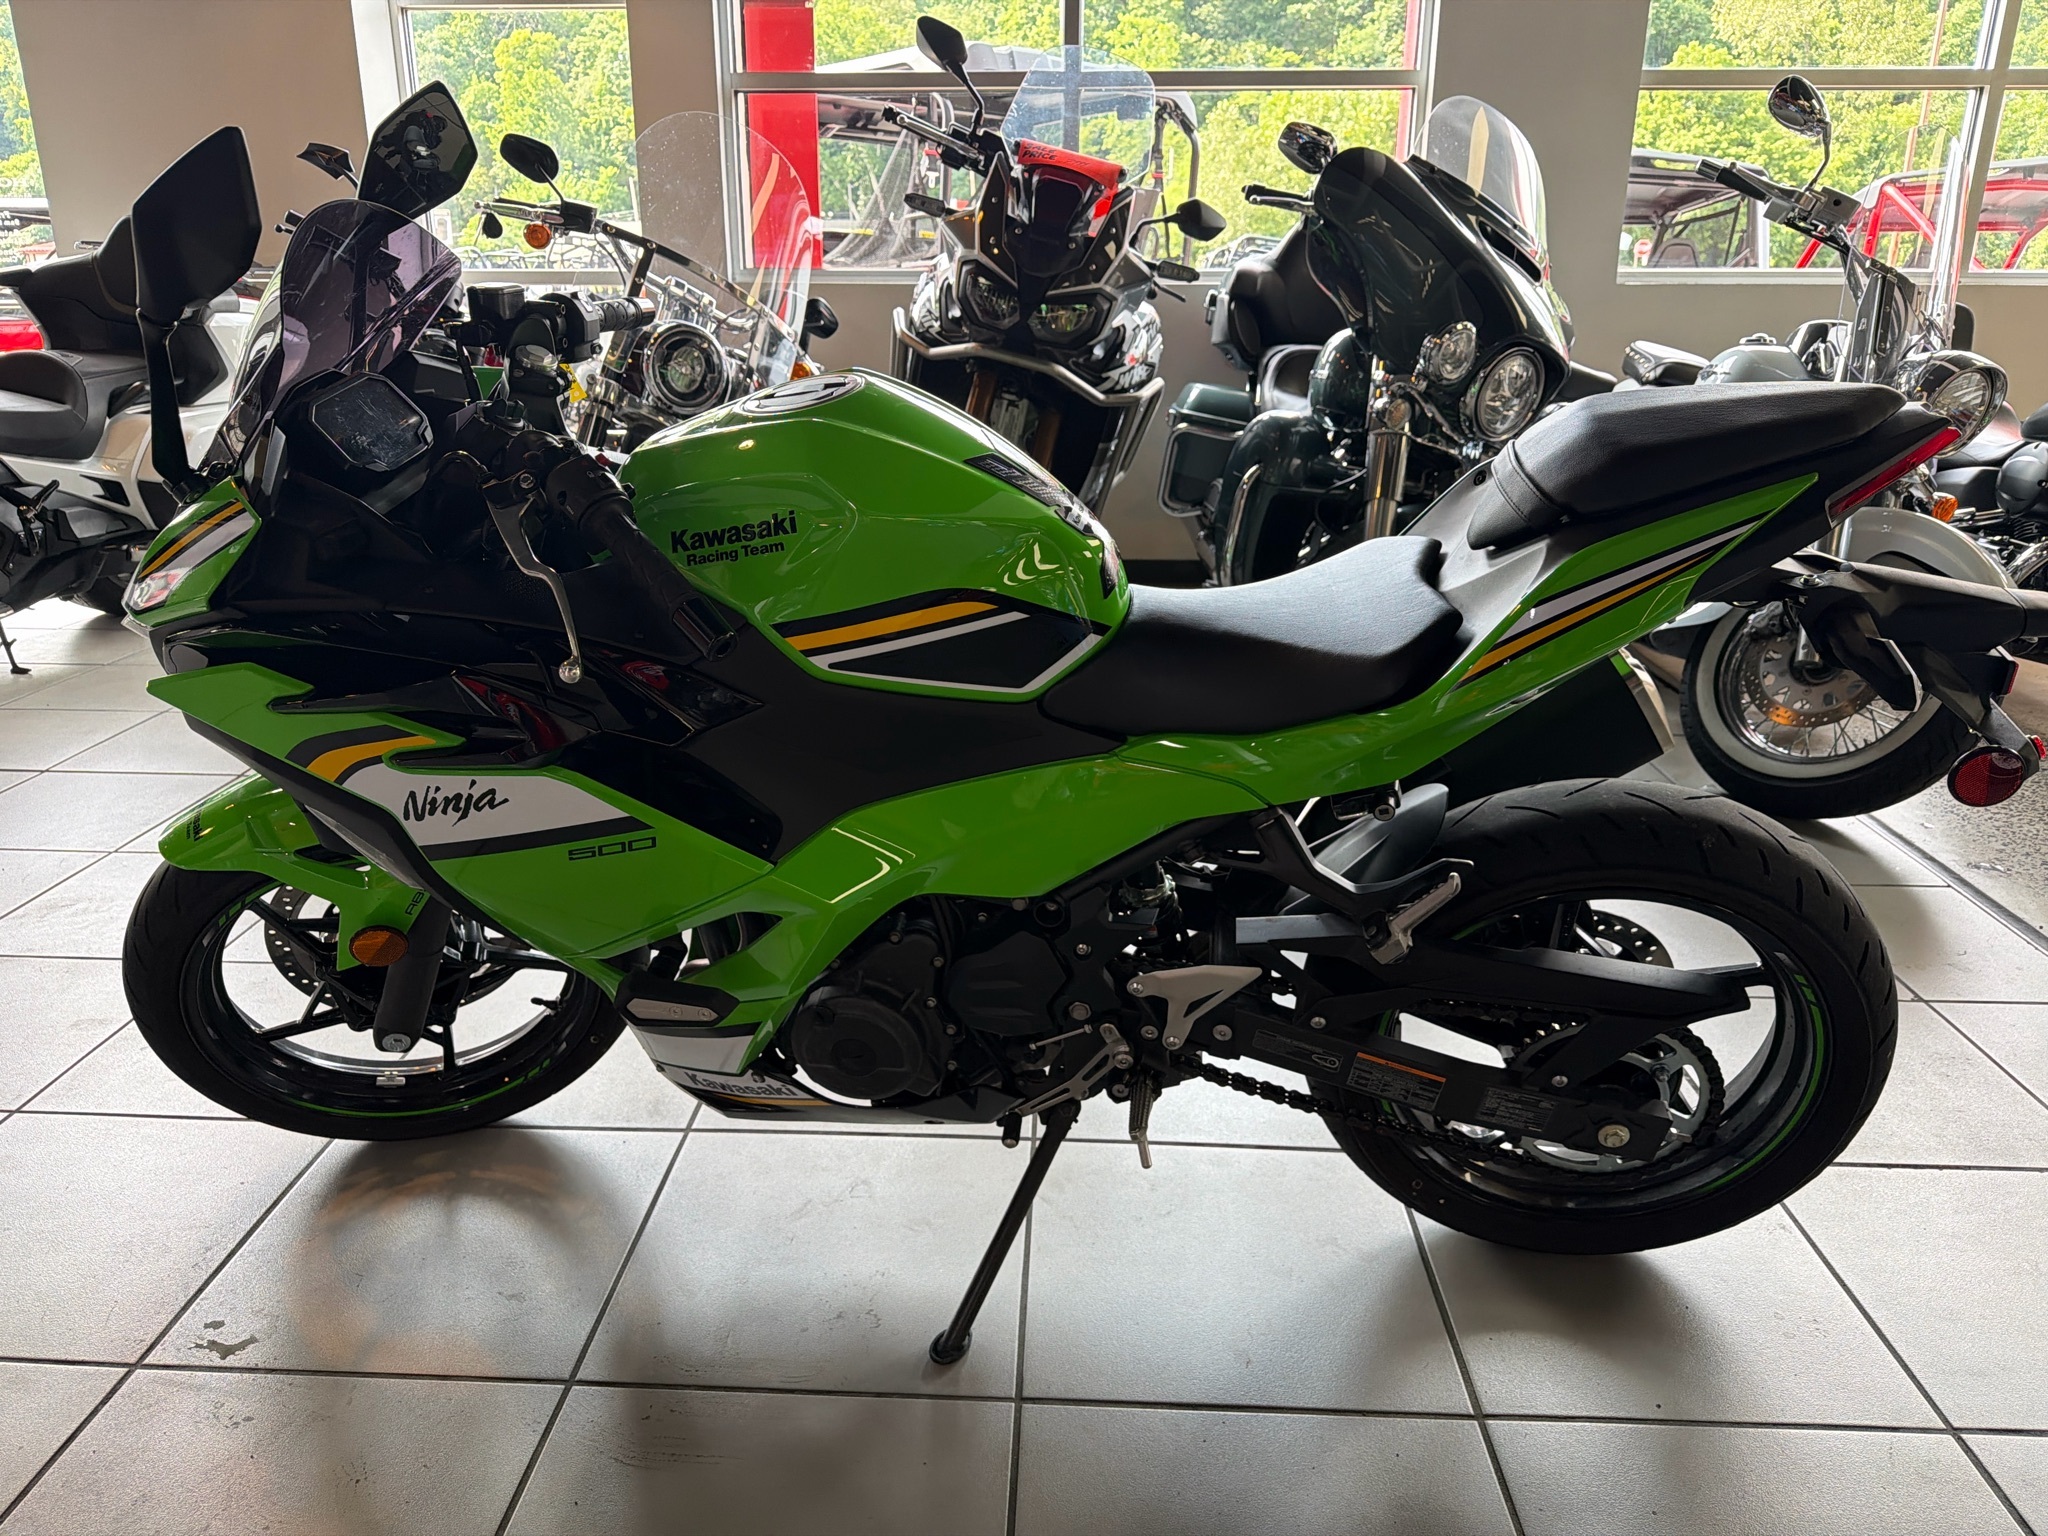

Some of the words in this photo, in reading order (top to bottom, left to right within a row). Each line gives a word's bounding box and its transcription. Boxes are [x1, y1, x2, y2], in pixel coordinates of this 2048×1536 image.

[1022, 150, 1058, 161] PRICE
[1023, 143, 1057, 154] SALE
[671, 509, 798, 554] Kawasaki
[686, 549, 739, 567] Racing
[741, 541, 785, 557] Team
[402, 778, 510, 828] Ninja
[567, 836, 657, 861] 500
[405, 890, 426, 916] AB
[684, 1071, 799, 1097] Kawasaki
